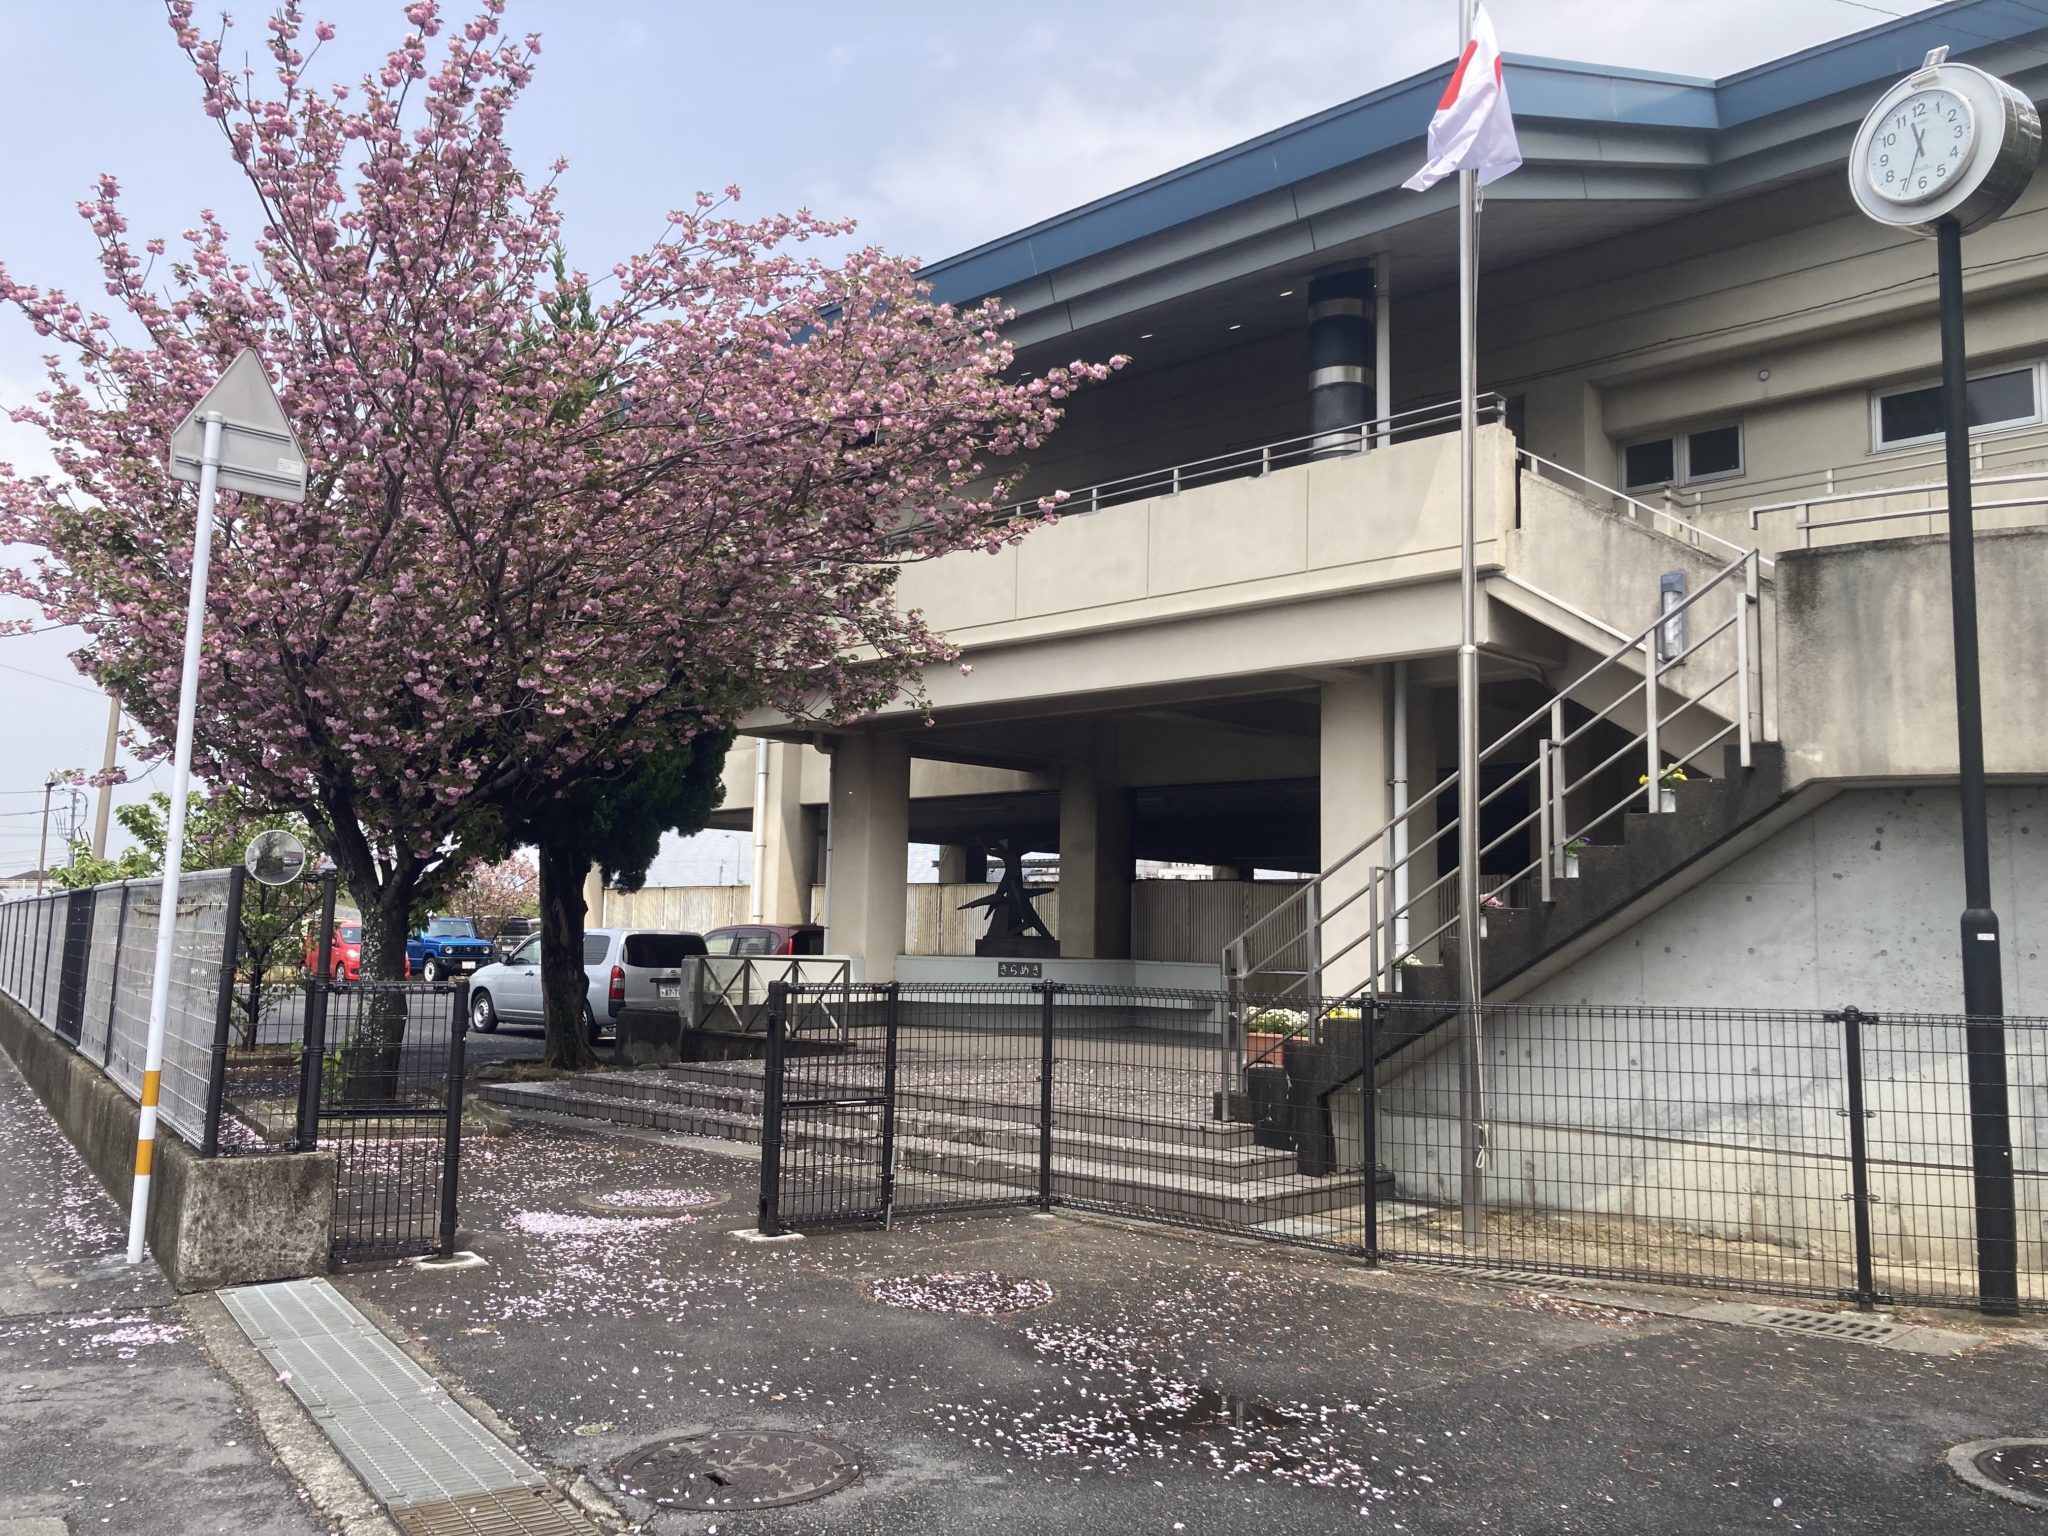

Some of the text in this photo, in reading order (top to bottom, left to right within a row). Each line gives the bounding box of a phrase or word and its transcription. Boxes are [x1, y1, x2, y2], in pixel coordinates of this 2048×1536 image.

[1912, 103, 1926, 118] 12
[1935, 101, 1940, 114] 1
[1896, 115, 1907, 129] 11
[1947, 109, 1958, 122] 2
[1953, 125, 1963, 138] 3
[1881, 133, 1896, 148] 10
[1949, 145, 1959, 158] 4
[1880, 154, 1889, 167] 9
[1885, 170, 1895, 183] 8
[1936, 163, 1947, 177] 5
[1899, 177, 1908, 191] 7
[1918, 176, 1928, 189] 6
[1000, 964, 1039, 976] きらめき
